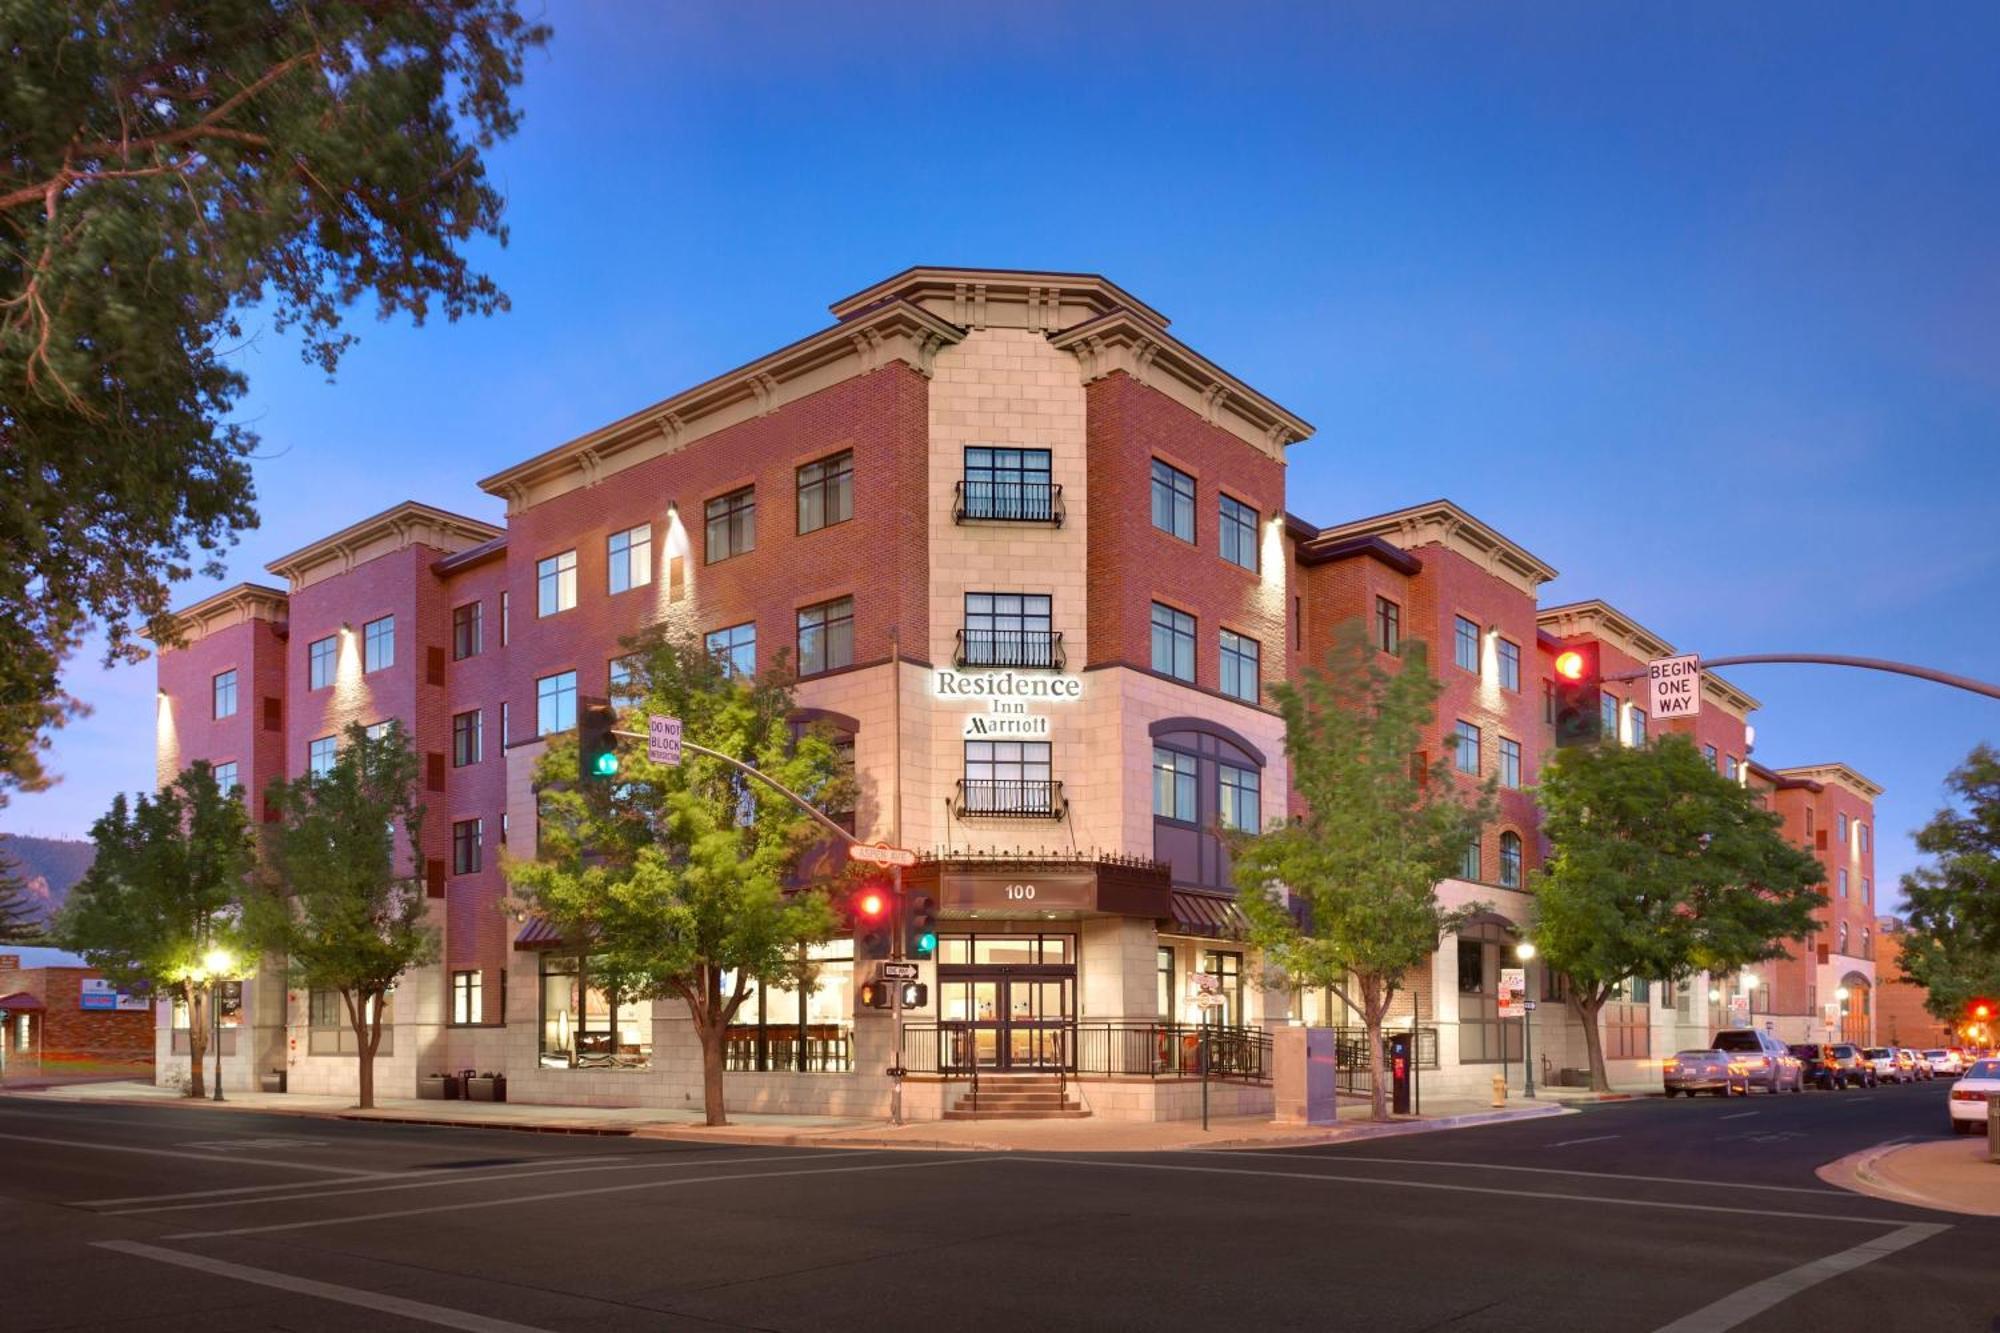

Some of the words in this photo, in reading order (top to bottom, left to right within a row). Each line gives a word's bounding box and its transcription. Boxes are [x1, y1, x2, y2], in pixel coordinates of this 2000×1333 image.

[1651, 661, 1697, 679] BEGIN
[937, 672, 1080, 696] Residence
[1658, 679, 1690, 695] ONE
[993, 699, 1024, 713] Inn
[1660, 696, 1691, 712] WAY
[651, 721, 663, 732] DO
[665, 723, 680, 735] NOT
[966, 717, 1046, 734] Marriott
[651, 737, 680, 750] BLOCK
[1005, 884, 1036, 900] 100
